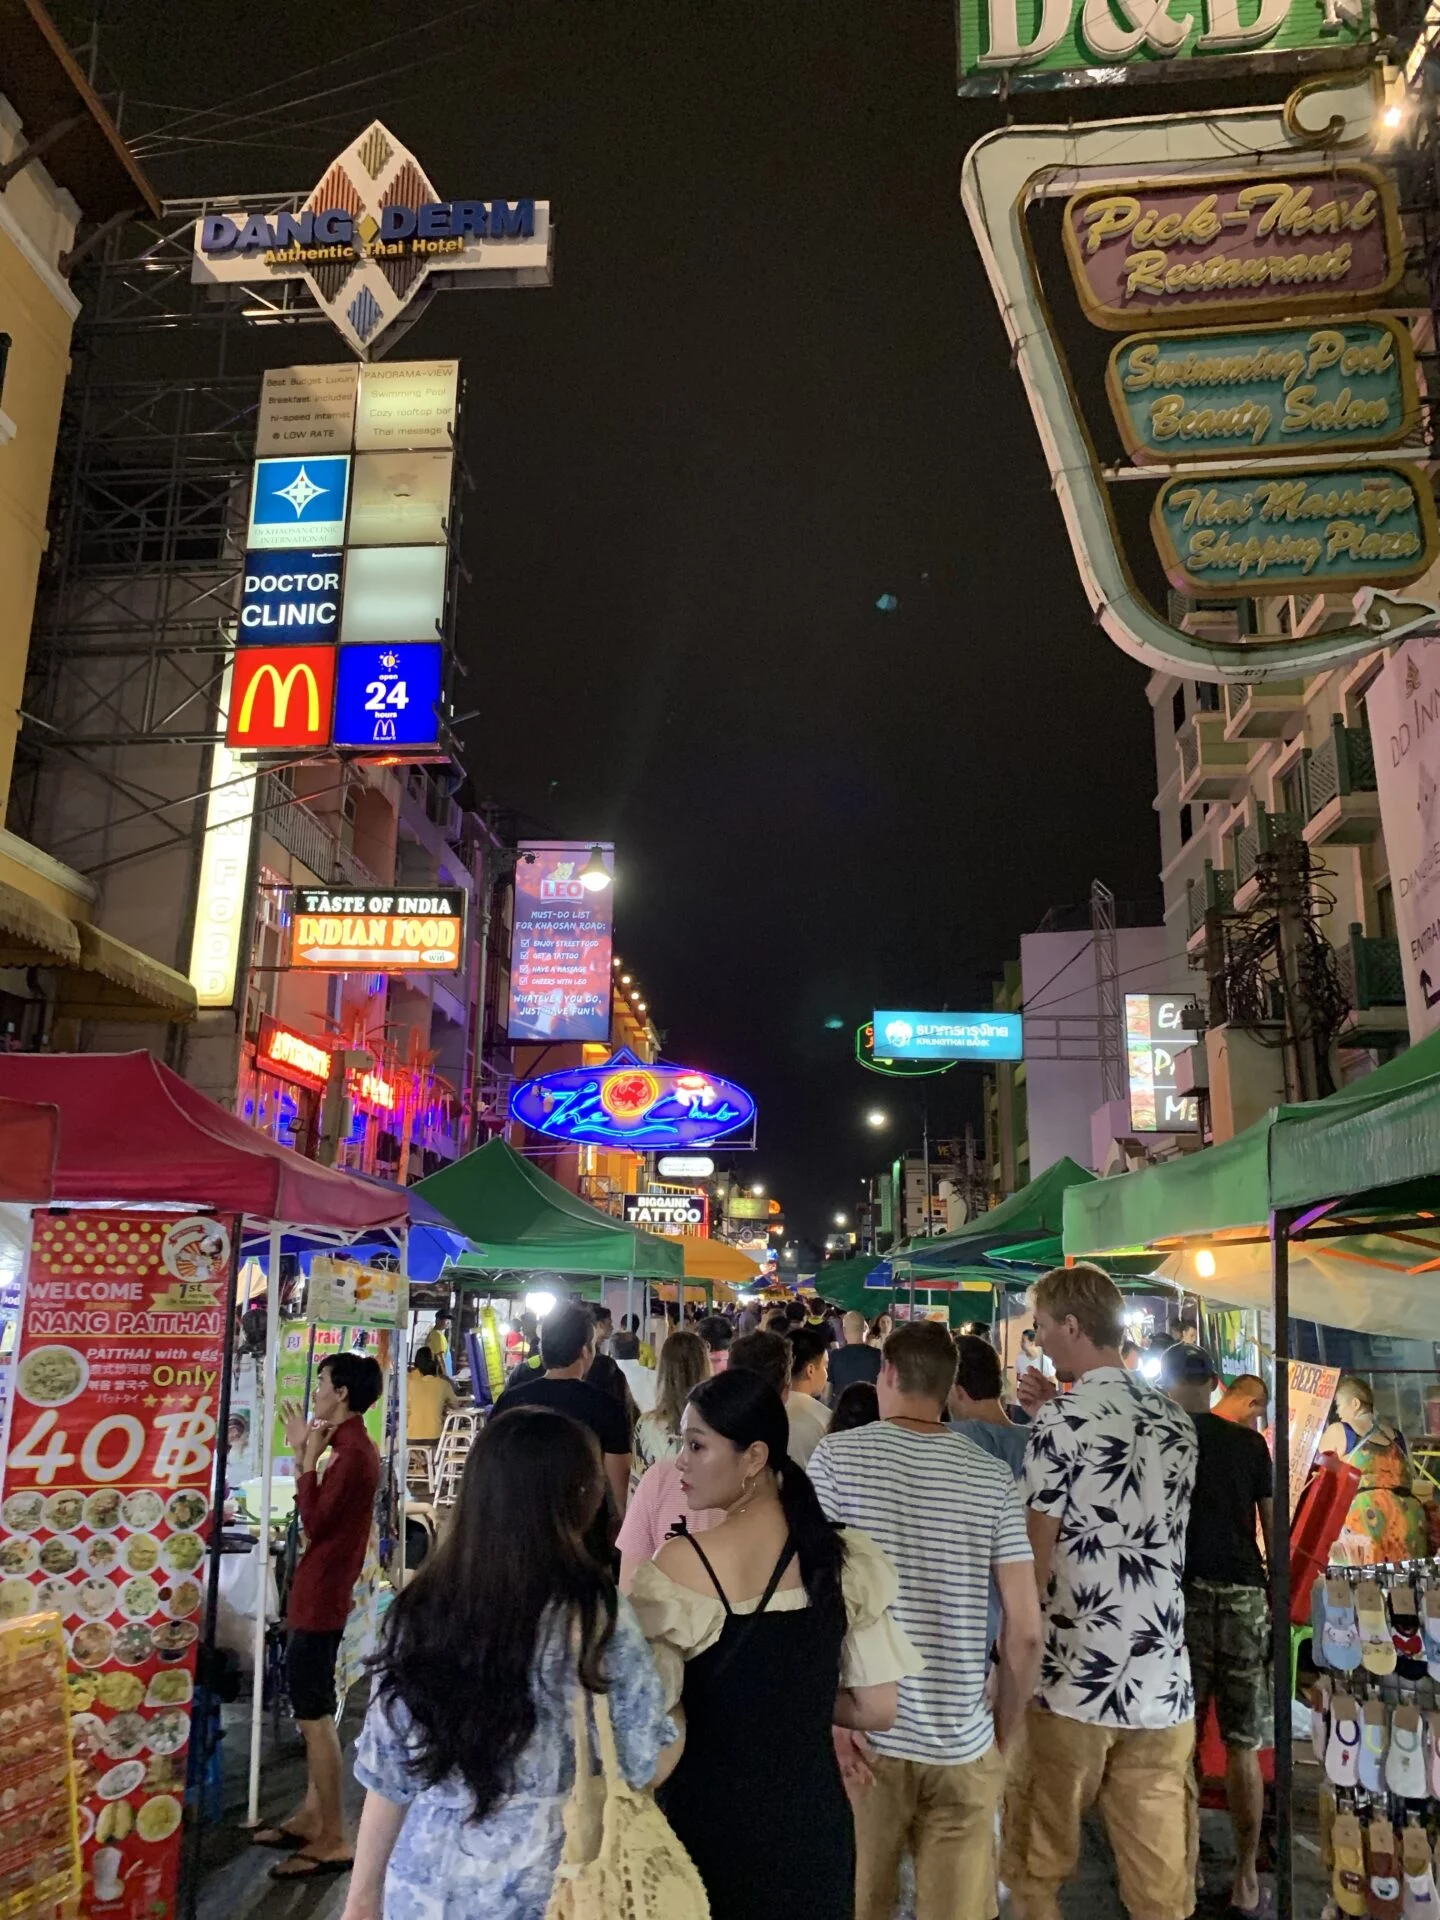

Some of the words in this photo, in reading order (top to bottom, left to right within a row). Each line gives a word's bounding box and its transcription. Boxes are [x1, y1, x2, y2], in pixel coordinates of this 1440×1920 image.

[201, 207, 354, 250] DANG
[380, 199, 535, 241] DERM
[1082, 182, 1378, 254] Pick-Thai
[263, 244, 354, 265] Authentic
[364, 240, 404, 256] Thai
[412, 236, 465, 254] Hotel
[1123, 242, 1353, 298] Restaurant
[1125, 343, 1307, 392] Swimming
[1305, 330, 1395, 380] Pool
[325, 376, 355, 384] Luxury
[364, 368, 454, 379] PANORAMA-VIEW
[268, 396, 310, 404] Breakfast
[314, 394, 353, 402] included
[370, 389, 421, 399] Swimming
[425, 387, 446, 397] Pool
[314, 411, 352, 420] internet
[369, 408, 393, 418] Cozy
[396, 407, 432, 417] rooftop
[436, 406, 453, 415] bar
[1151, 393, 1272, 445] Beauty
[1280, 384, 1390, 434] Salon
[283, 431, 306, 440] LOW
[310, 429, 335, 438] RATE
[373, 427, 394, 436] Thai
[1168, 487, 1254, 531] Thai
[1254, 480, 1415, 527] Massage
[1186, 528, 1322, 576] Shopping
[1323, 519, 1421, 563] Plaza
[244, 572, 340, 593] DOCTOR
[240, 602, 337, 627] CLINIC
[378, 673, 399, 682] open
[364, 680, 410, 711] 24
[374, 711, 398, 719] hours
[543, 881, 583, 898] LEO
[306, 895, 366, 913] TASTE
[368, 896, 394, 914] OF
[397, 897, 452, 915] INDIA
[531, 911, 570, 919] MUST-DO
[572, 911, 590, 919] LIST
[298, 917, 388, 946] INDIAN
[391, 918, 456, 948] FOOD
[515, 922, 533, 930] FOR
[535, 921, 577, 930] KHAOSAN
[553, 952, 579, 960] TATTOO
[532, 965, 549, 973] HAVE
[557, 965, 588, 974] MASSAGE
[531, 977, 556, 985] CHEERS
[514, 994, 562, 1004] WHATEVER
[564, 994, 584, 1004] YOU
[519, 1006, 540, 1016] JUST
[542, 1006, 569, 1016] HAVE
[916, 1038, 965, 1048] KRUNGTHAI
[966, 1038, 990, 1048] BANK
[540, 1082, 612, 1131] The
[642, 1094, 739, 1123] Club
[627, 1206, 701, 1223] TATTOO
[27, 1281, 144, 1301] WELCOME
[28, 1310, 110, 1334] NANG
[115, 1311, 220, 1335] PATTHAI
[87, 1348, 152, 1360] PATTHAI
[155, 1348, 188, 1360] with
[192, 1349, 219, 1363] egg
[152, 1364, 217, 1393] Only
